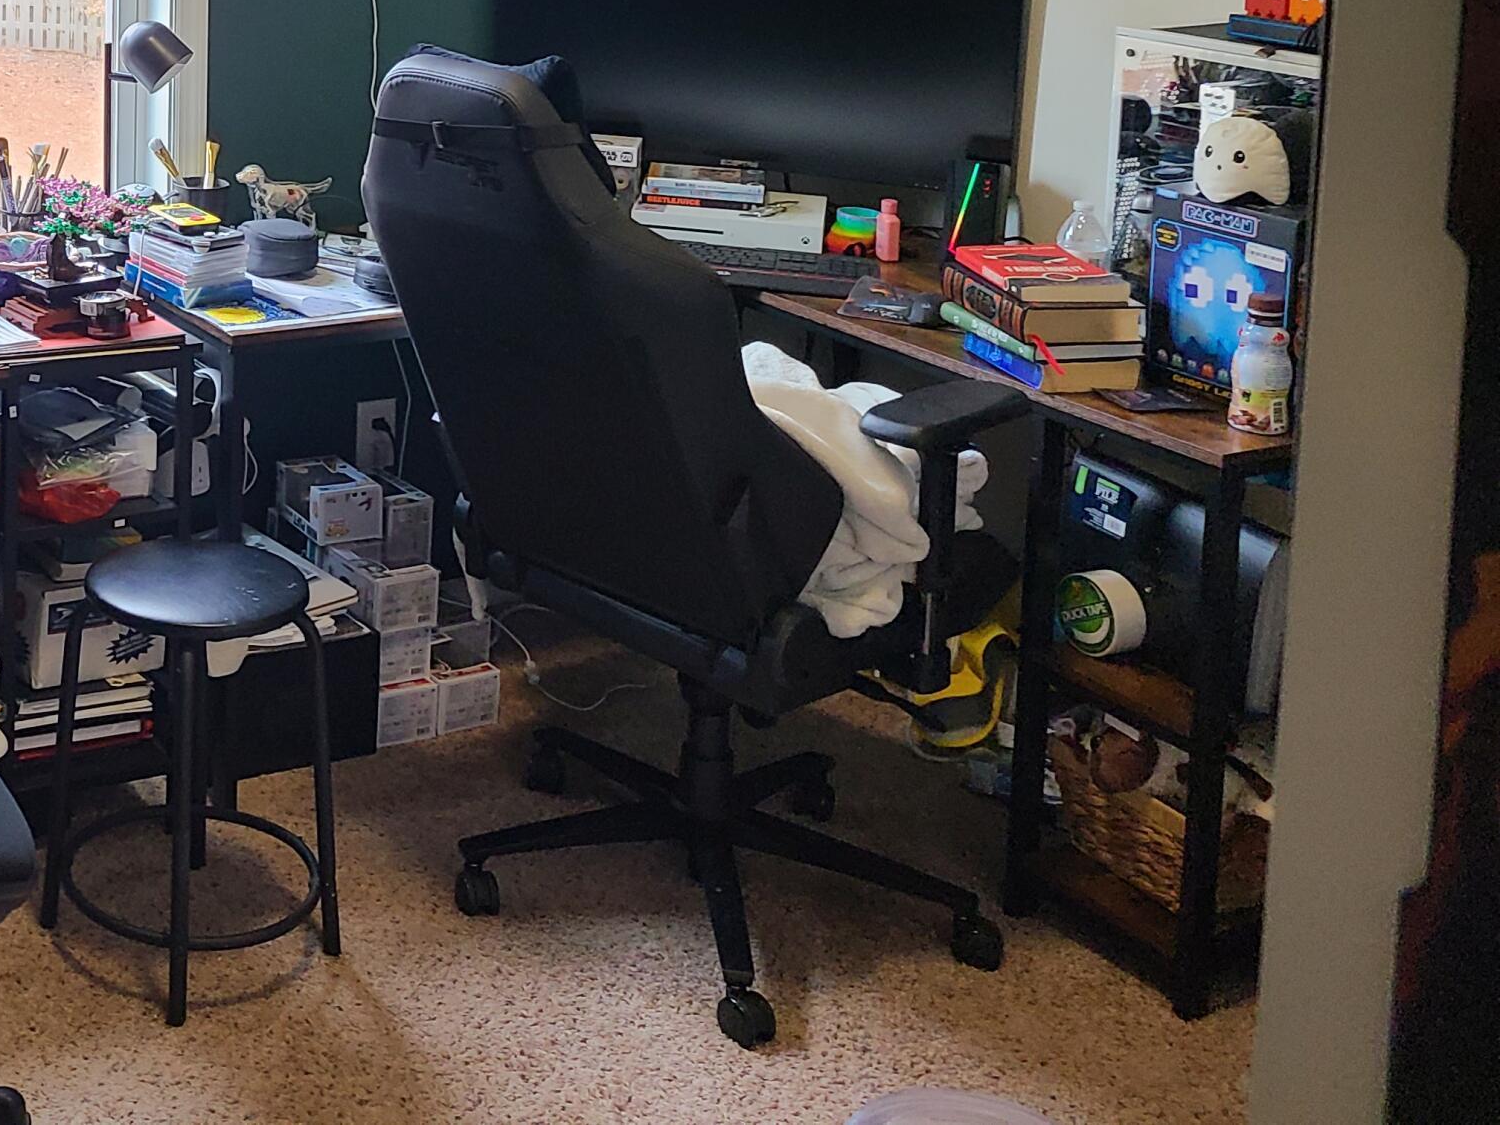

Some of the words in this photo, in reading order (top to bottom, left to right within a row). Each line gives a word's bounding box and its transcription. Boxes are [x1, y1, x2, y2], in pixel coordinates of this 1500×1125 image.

[646, 194, 702, 207] BEETLEJUICE
[1185, 204, 1254, 234] PAC-MAN
[1061, 608, 1086, 623] DUCK
[1086, 602, 1108, 616] TAPE
